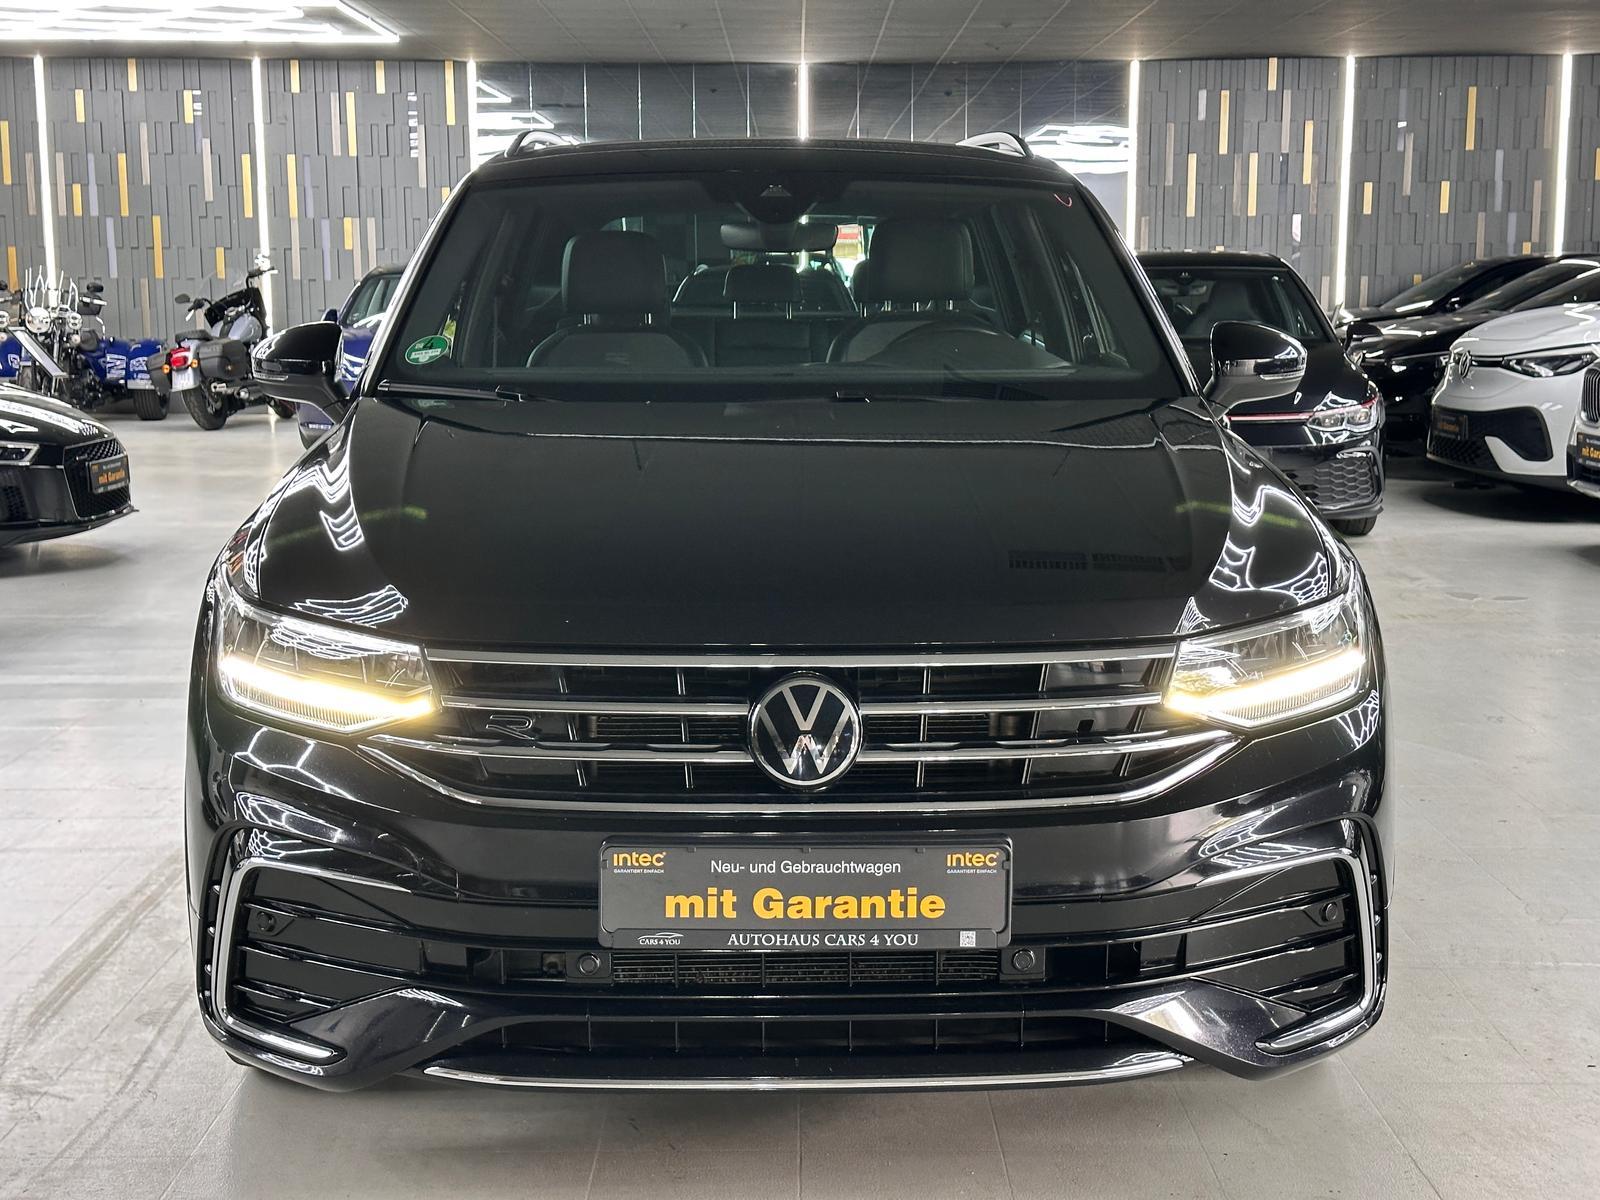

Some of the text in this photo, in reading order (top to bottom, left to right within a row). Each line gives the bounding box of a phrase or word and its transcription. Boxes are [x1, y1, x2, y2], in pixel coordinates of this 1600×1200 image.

[422, 337, 434, 350] 4
[613, 851, 667, 867] intec
[946, 851, 999, 867] intec
[710, 860, 901, 877] Neu- und Gebrauchtwagen
[665, 887, 946, 920] mit Garantie
[727, 933, 919, 947] AUTOHAUS CARS 4 YOU
